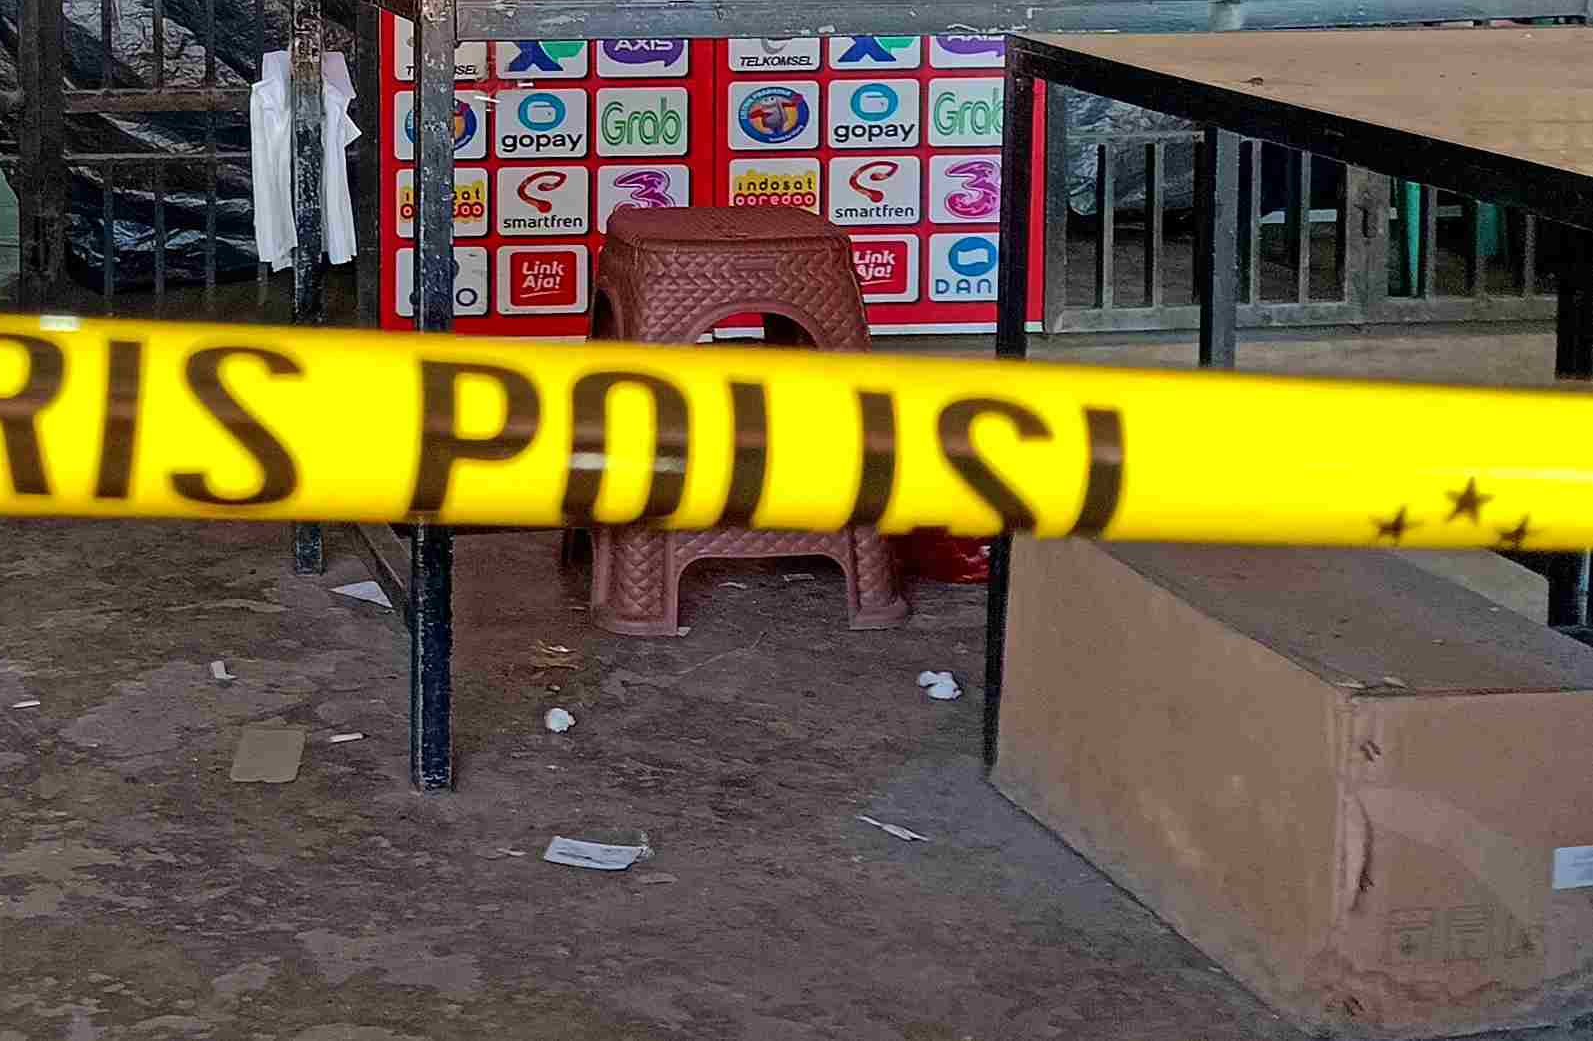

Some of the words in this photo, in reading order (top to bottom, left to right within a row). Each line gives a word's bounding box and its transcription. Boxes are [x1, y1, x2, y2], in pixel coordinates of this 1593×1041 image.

[740, 56, 813, 67] TELKOMSEL
[601, 96, 682, 147] Grab
[834, 124, 915, 143] gopay
[502, 131, 583, 153] gopay
[737, 178, 814, 192] indosat
[835, 205, 914, 218] smartfren
[503, 215, 583, 229] smartfren
[854, 250, 895, 266] Link
[521, 261, 565, 276] Link
[522, 275, 561, 289] Aja!
[935, 279, 992, 295] DAN
